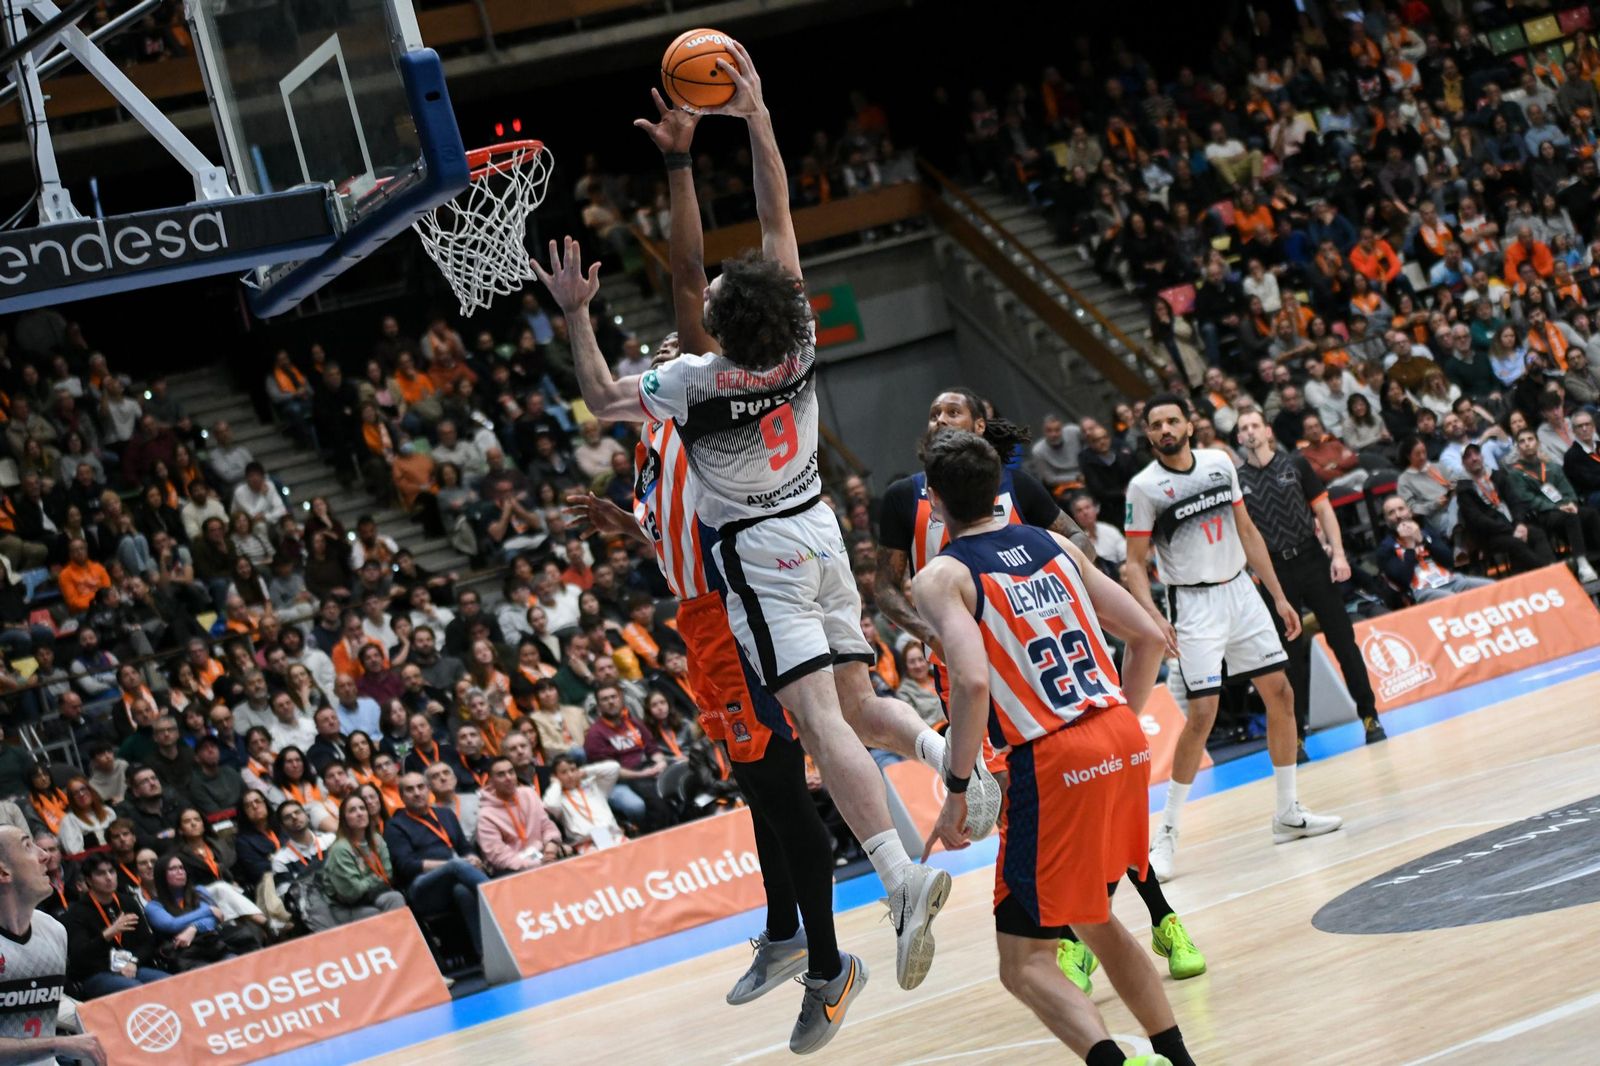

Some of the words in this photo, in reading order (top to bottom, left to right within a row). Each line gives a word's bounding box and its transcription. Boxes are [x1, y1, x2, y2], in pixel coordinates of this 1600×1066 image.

[0, 210, 229, 285] endesa
[759, 402, 799, 472] 9
[997, 544, 1033, 568] FONT
[1200, 515, 1223, 545] 17
[1005, 575, 1071, 616] LEYMA
[1428, 588, 1566, 643] Fagamos
[1026, 629, 1110, 711] 22
[1062, 754, 1124, 788] Nordés
[515, 885, 645, 943] Estrella
[644, 849, 763, 901] Galicia
[190, 945, 399, 1028] PROSEGUR
[206, 997, 342, 1056] SECURITY
